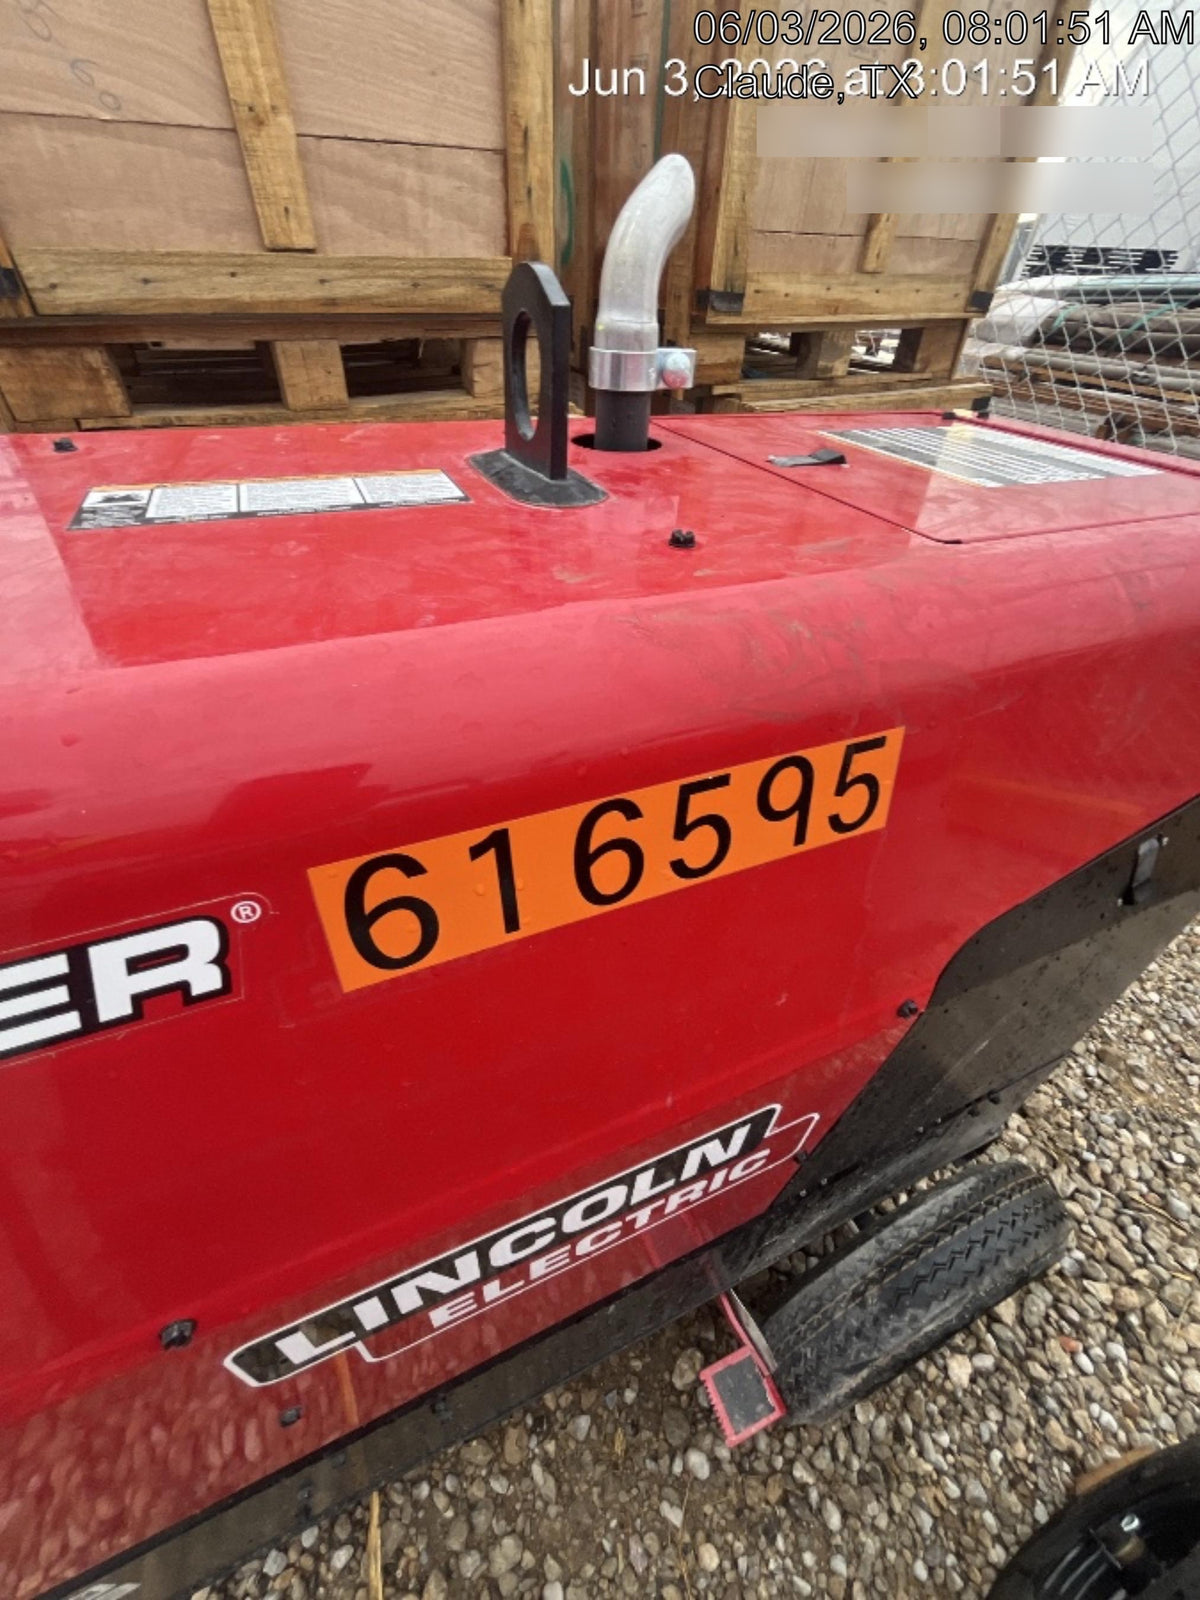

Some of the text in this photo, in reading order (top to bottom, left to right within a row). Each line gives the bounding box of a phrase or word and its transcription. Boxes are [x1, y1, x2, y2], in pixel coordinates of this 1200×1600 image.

[343, 735, 888, 971] 616595
[274, 1122, 751, 1366] LINCOLN
[429, 1147, 771, 1329] ELECTRIC
